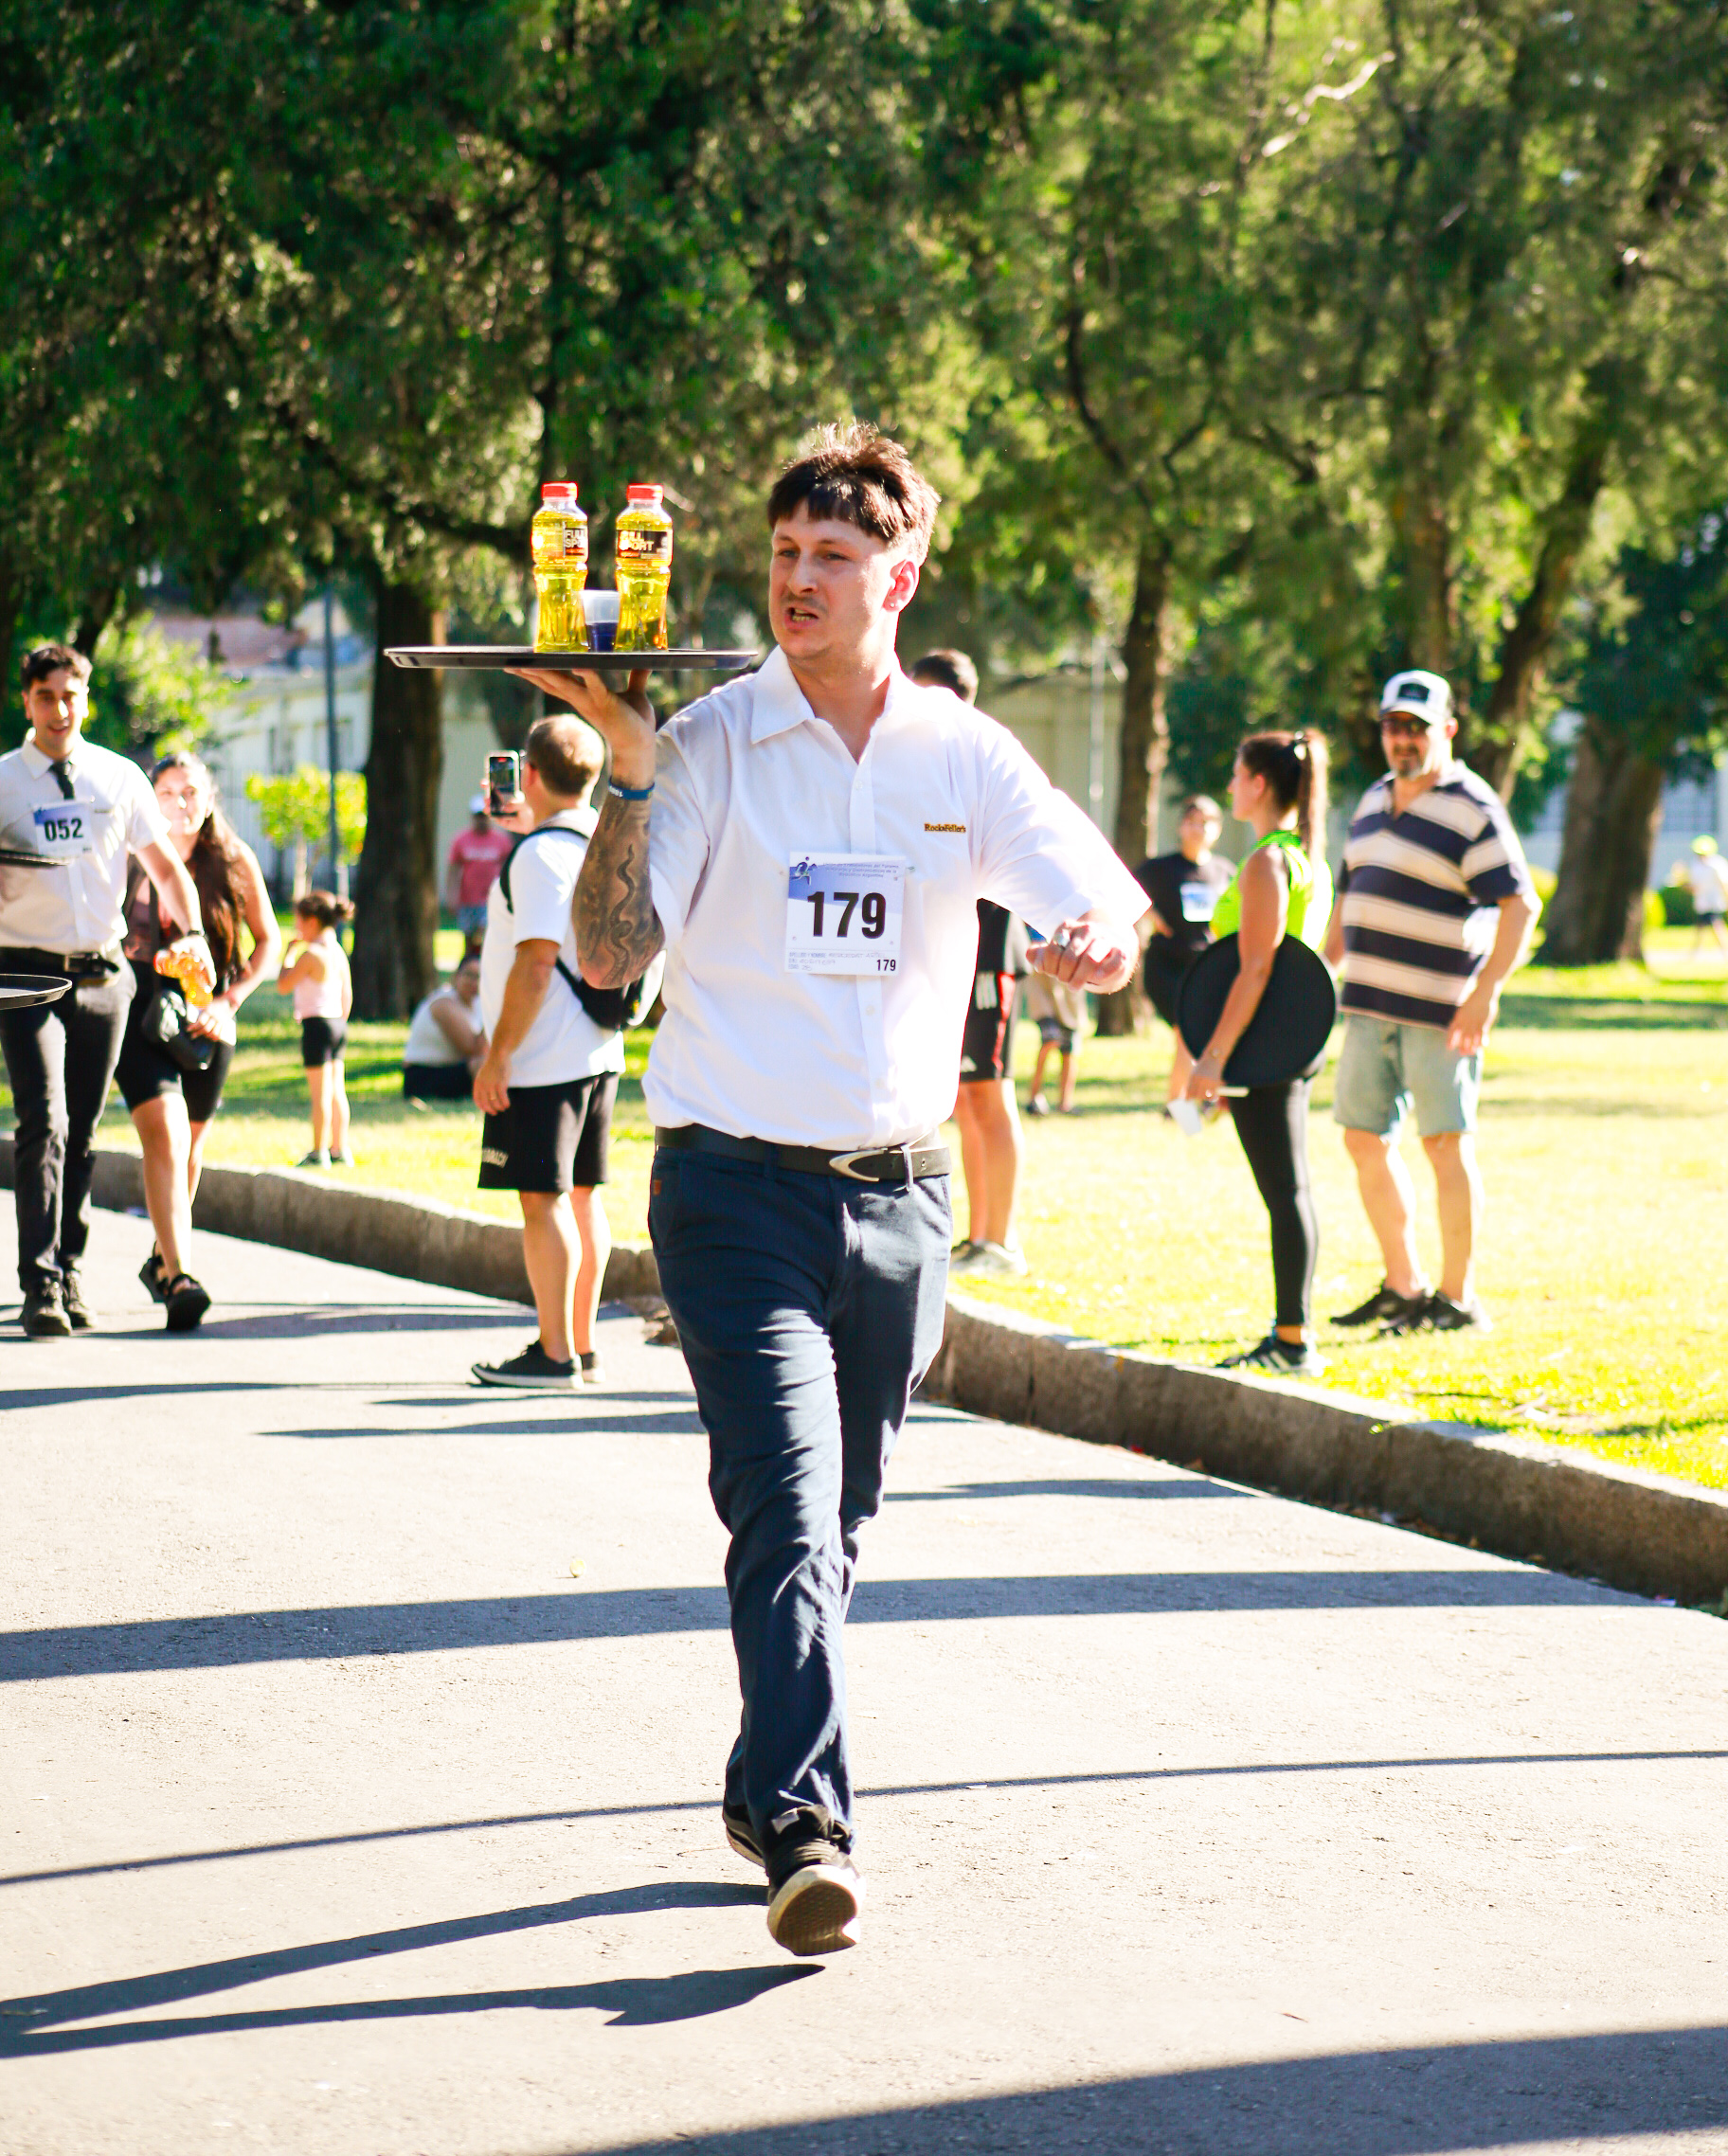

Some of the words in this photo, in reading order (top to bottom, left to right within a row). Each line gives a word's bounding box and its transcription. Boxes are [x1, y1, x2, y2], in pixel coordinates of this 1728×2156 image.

[44, 817, 83, 841] 052
[807, 891, 887, 939] 179
[876, 959, 896, 971] 179
